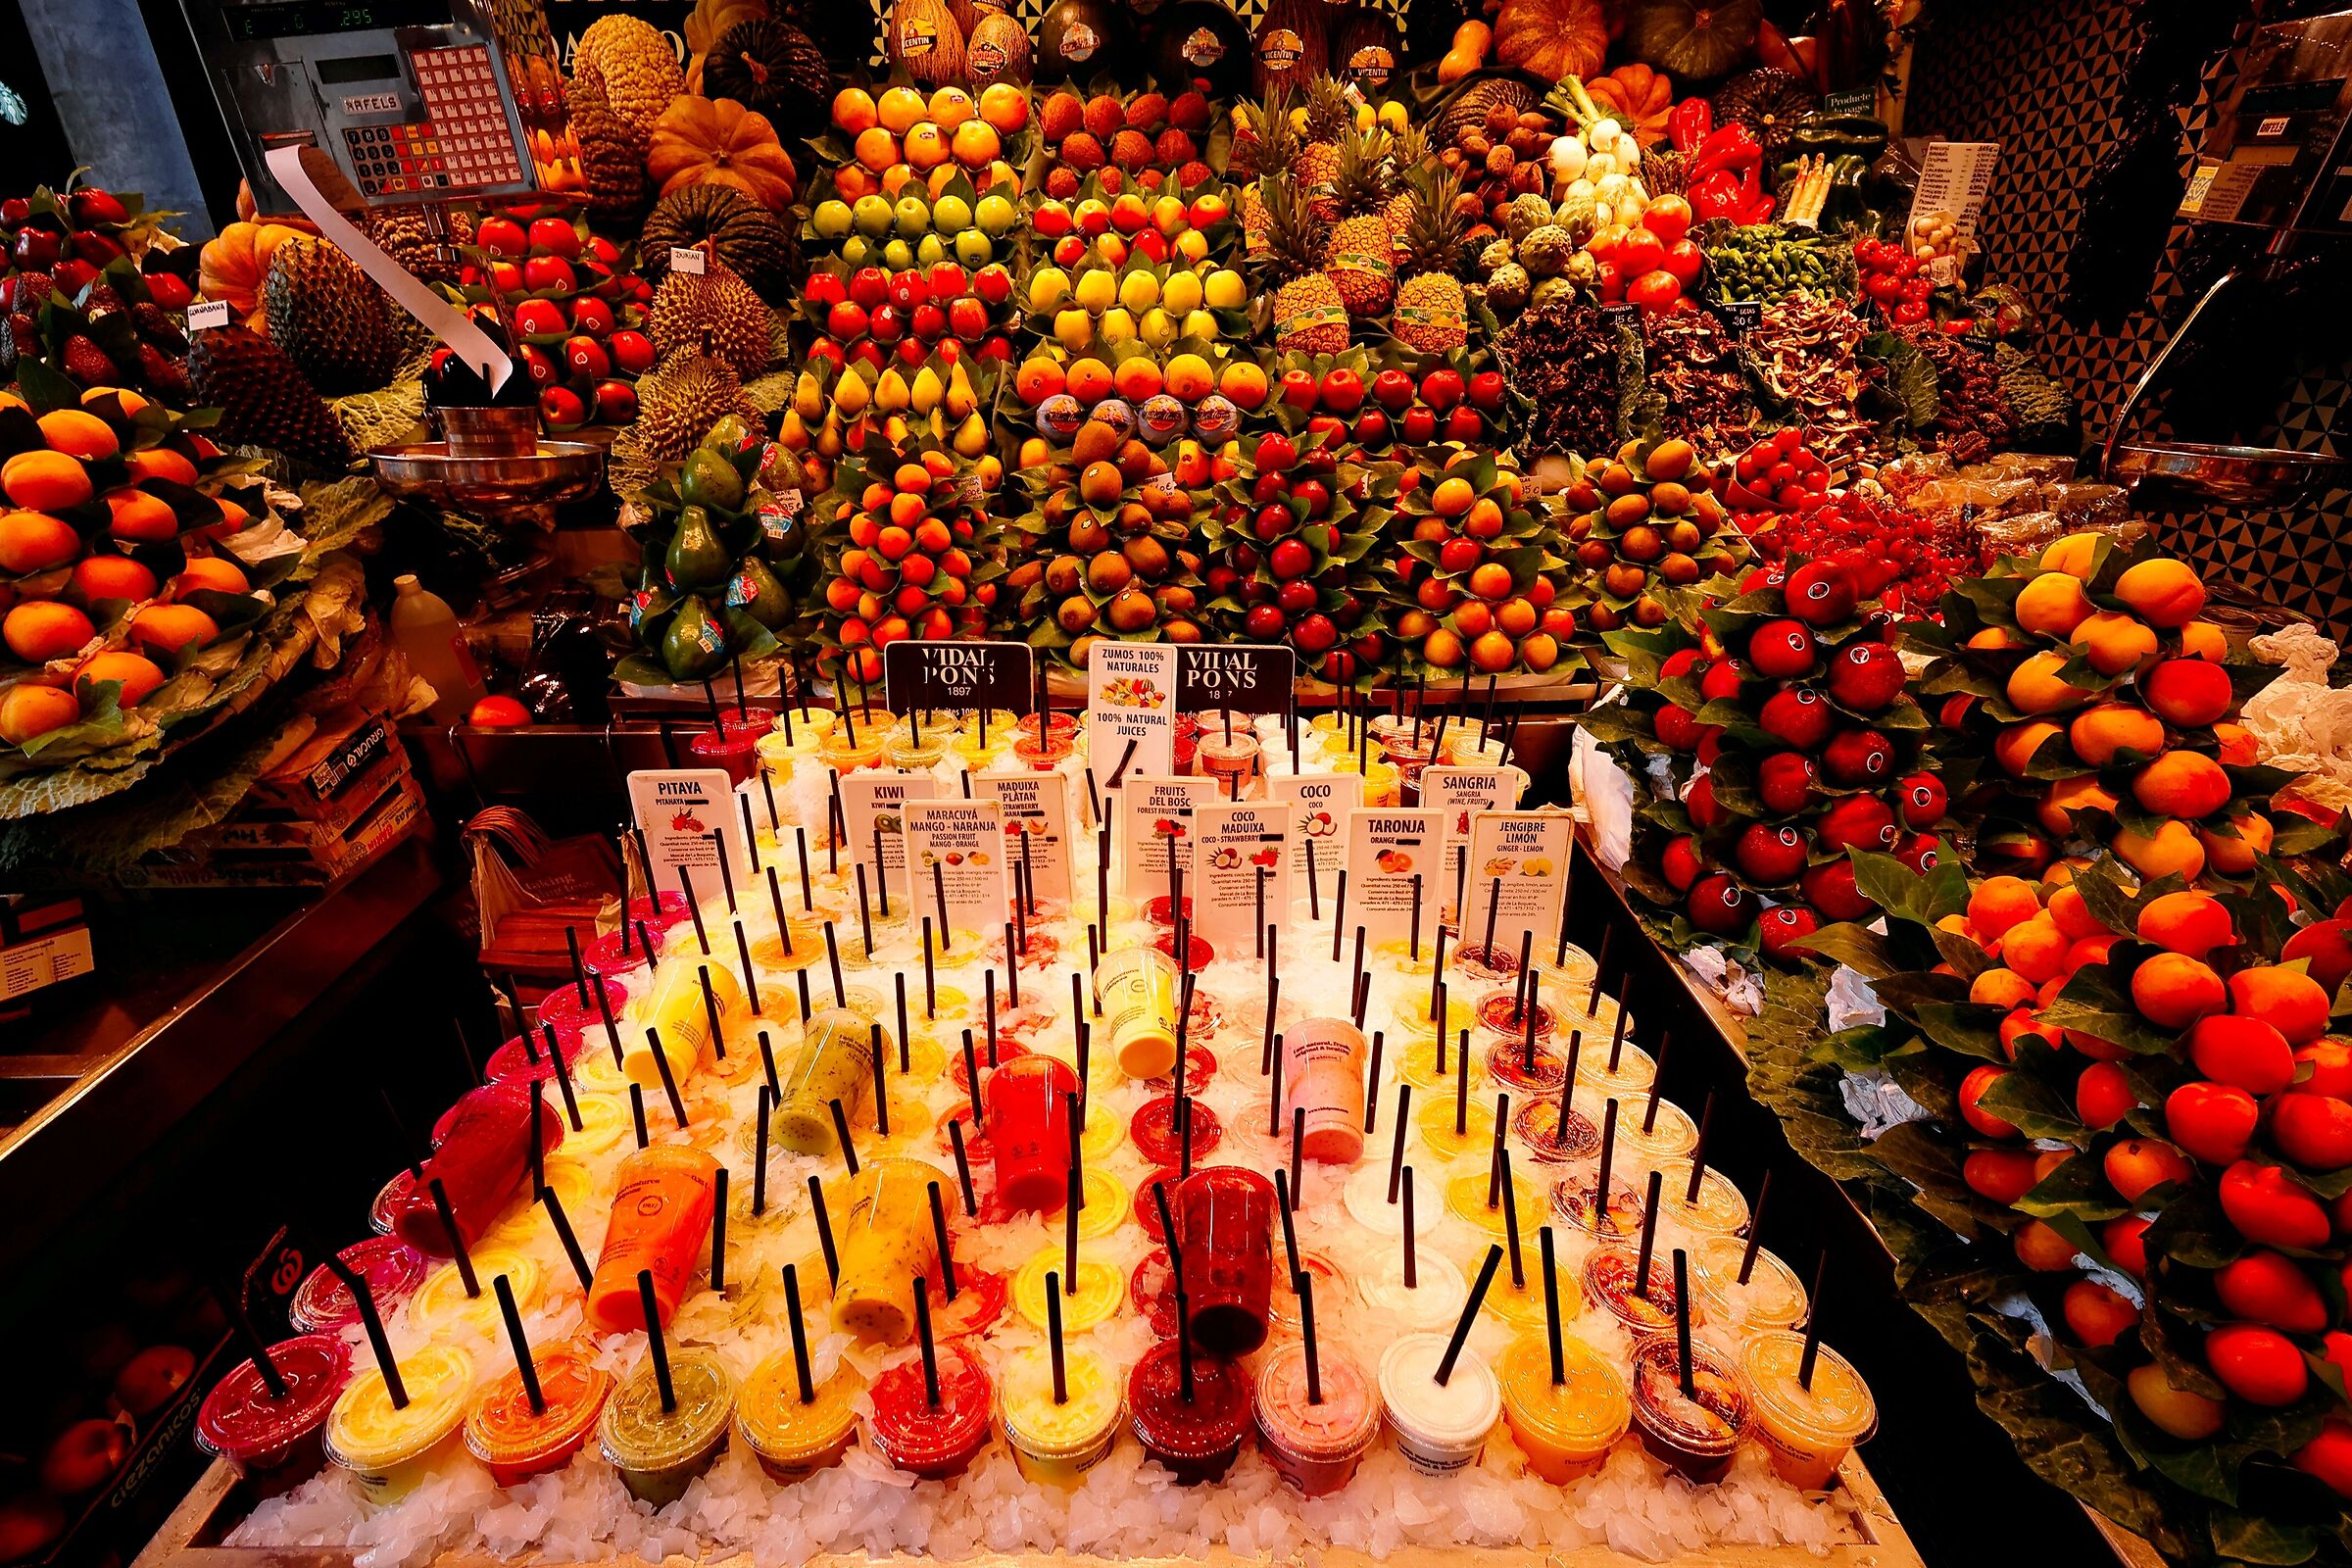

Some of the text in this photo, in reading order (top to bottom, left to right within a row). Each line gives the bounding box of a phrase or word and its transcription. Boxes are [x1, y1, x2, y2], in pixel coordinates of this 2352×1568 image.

[1264, 49, 1295, 60] VICENTIN
[1357, 68, 1389, 77] VICENTIN
[1102, 649, 1164, 662] ZUMOS 100%
[1106, 661, 1159, 673] NATURALES
[1187, 669, 1256, 689] PONS
[948, 687, 971, 696] 1897
[1209, 690, 1233, 700] 187
[1097, 712, 1167, 726] 100% NATURAL
[1116, 725, 1147, 736] JUICES
[658, 781, 703, 795] PITAYA
[998, 781, 1040, 792] MADUIXA
[1443, 776, 1496, 790] SANGRIA
[874, 786, 905, 799] KIWI
[1155, 786, 1186, 796] FRUITS
[1300, 785, 1331, 798] COCO
[1150, 797, 1191, 807] DEL BOSC
[926, 808, 978, 820] MARACUYÁ
[1231, 811, 1254, 822] COCO
[910, 822, 997, 832] MANGO NARANJA
[1221, 823, 1265, 834] MADUIXA
[1368, 819, 1425, 833] TARONJA
[1499, 822, 1545, 832] JENGIBRE
[1505, 832, 1537, 843] LIMÓN
